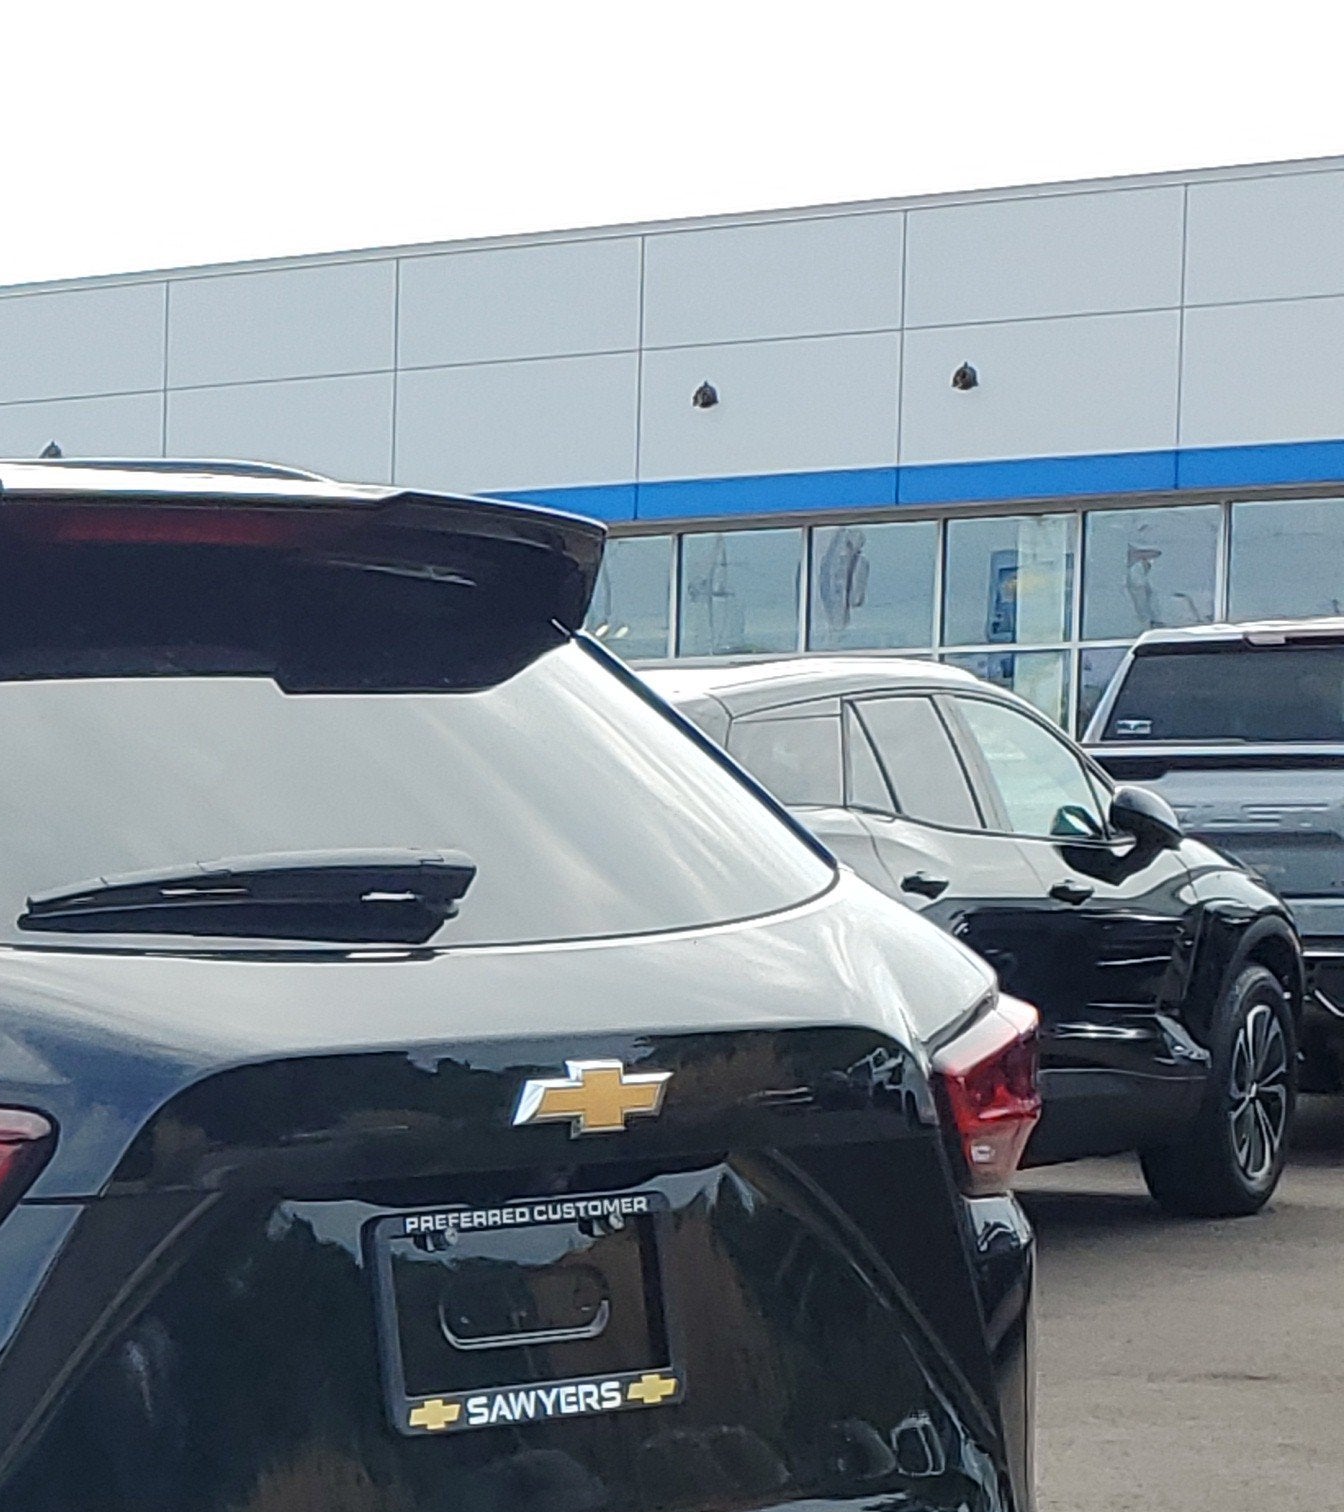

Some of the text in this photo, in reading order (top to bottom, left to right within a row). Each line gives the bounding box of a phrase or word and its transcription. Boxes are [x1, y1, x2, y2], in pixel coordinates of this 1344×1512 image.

[405, 1195, 649, 1233] PREFERRED CUSTOMER
[466, 1380, 622, 1425] SAWYERS
